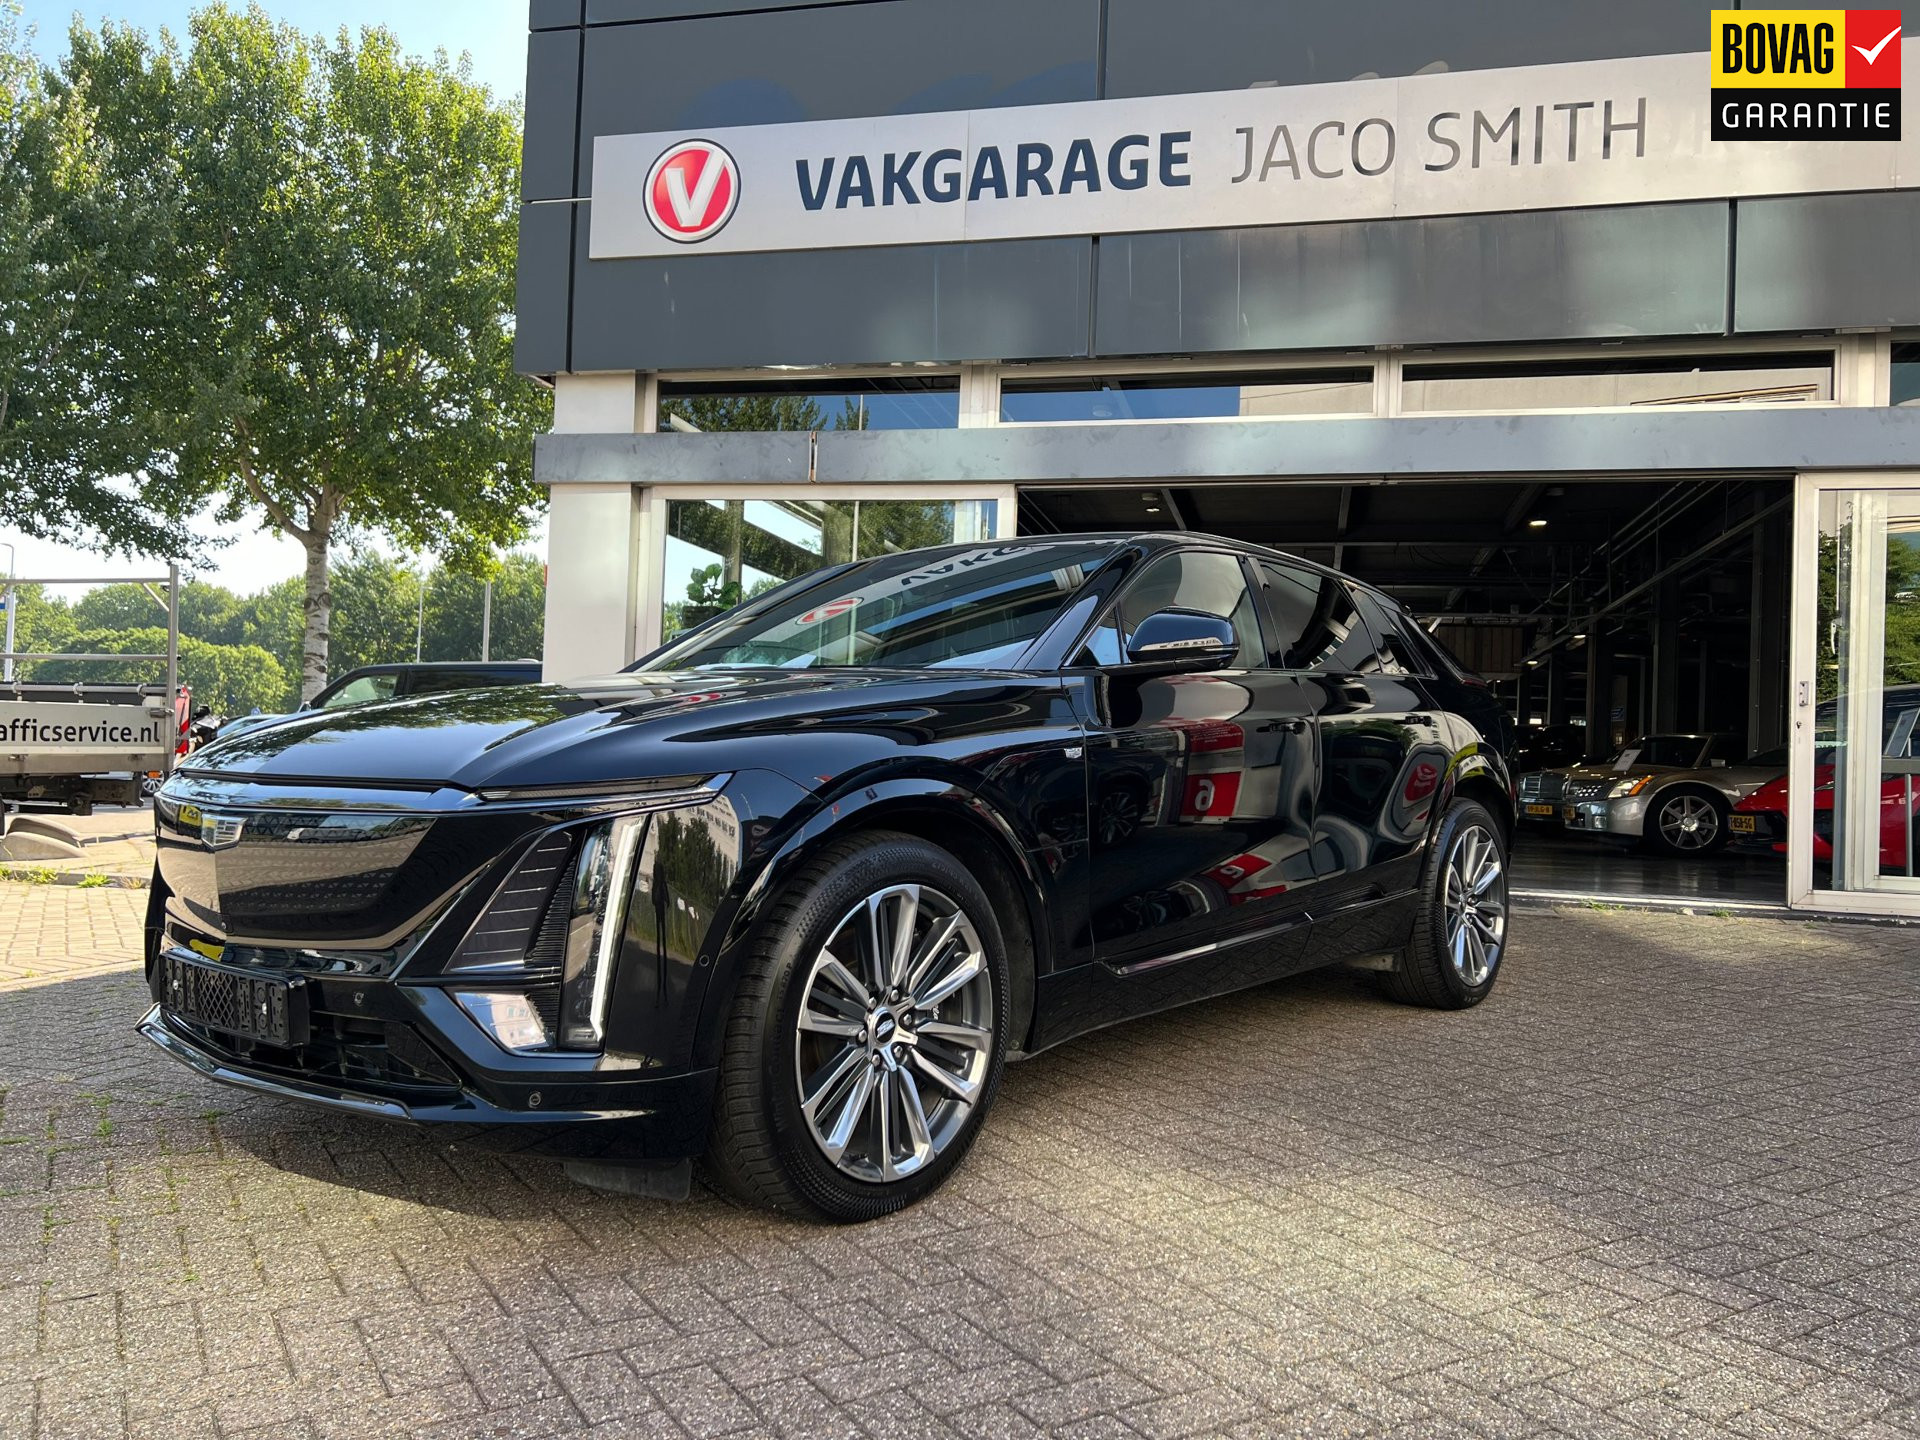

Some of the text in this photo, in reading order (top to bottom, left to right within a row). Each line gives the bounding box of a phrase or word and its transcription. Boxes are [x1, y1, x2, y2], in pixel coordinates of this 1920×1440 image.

[795, 131, 1191, 211] VAKGARAGE
[1231, 118, 1396, 184] JACO
[1424, 97, 1647, 172] SMITH
[0, 718, 160, 743] afficservice.nl
